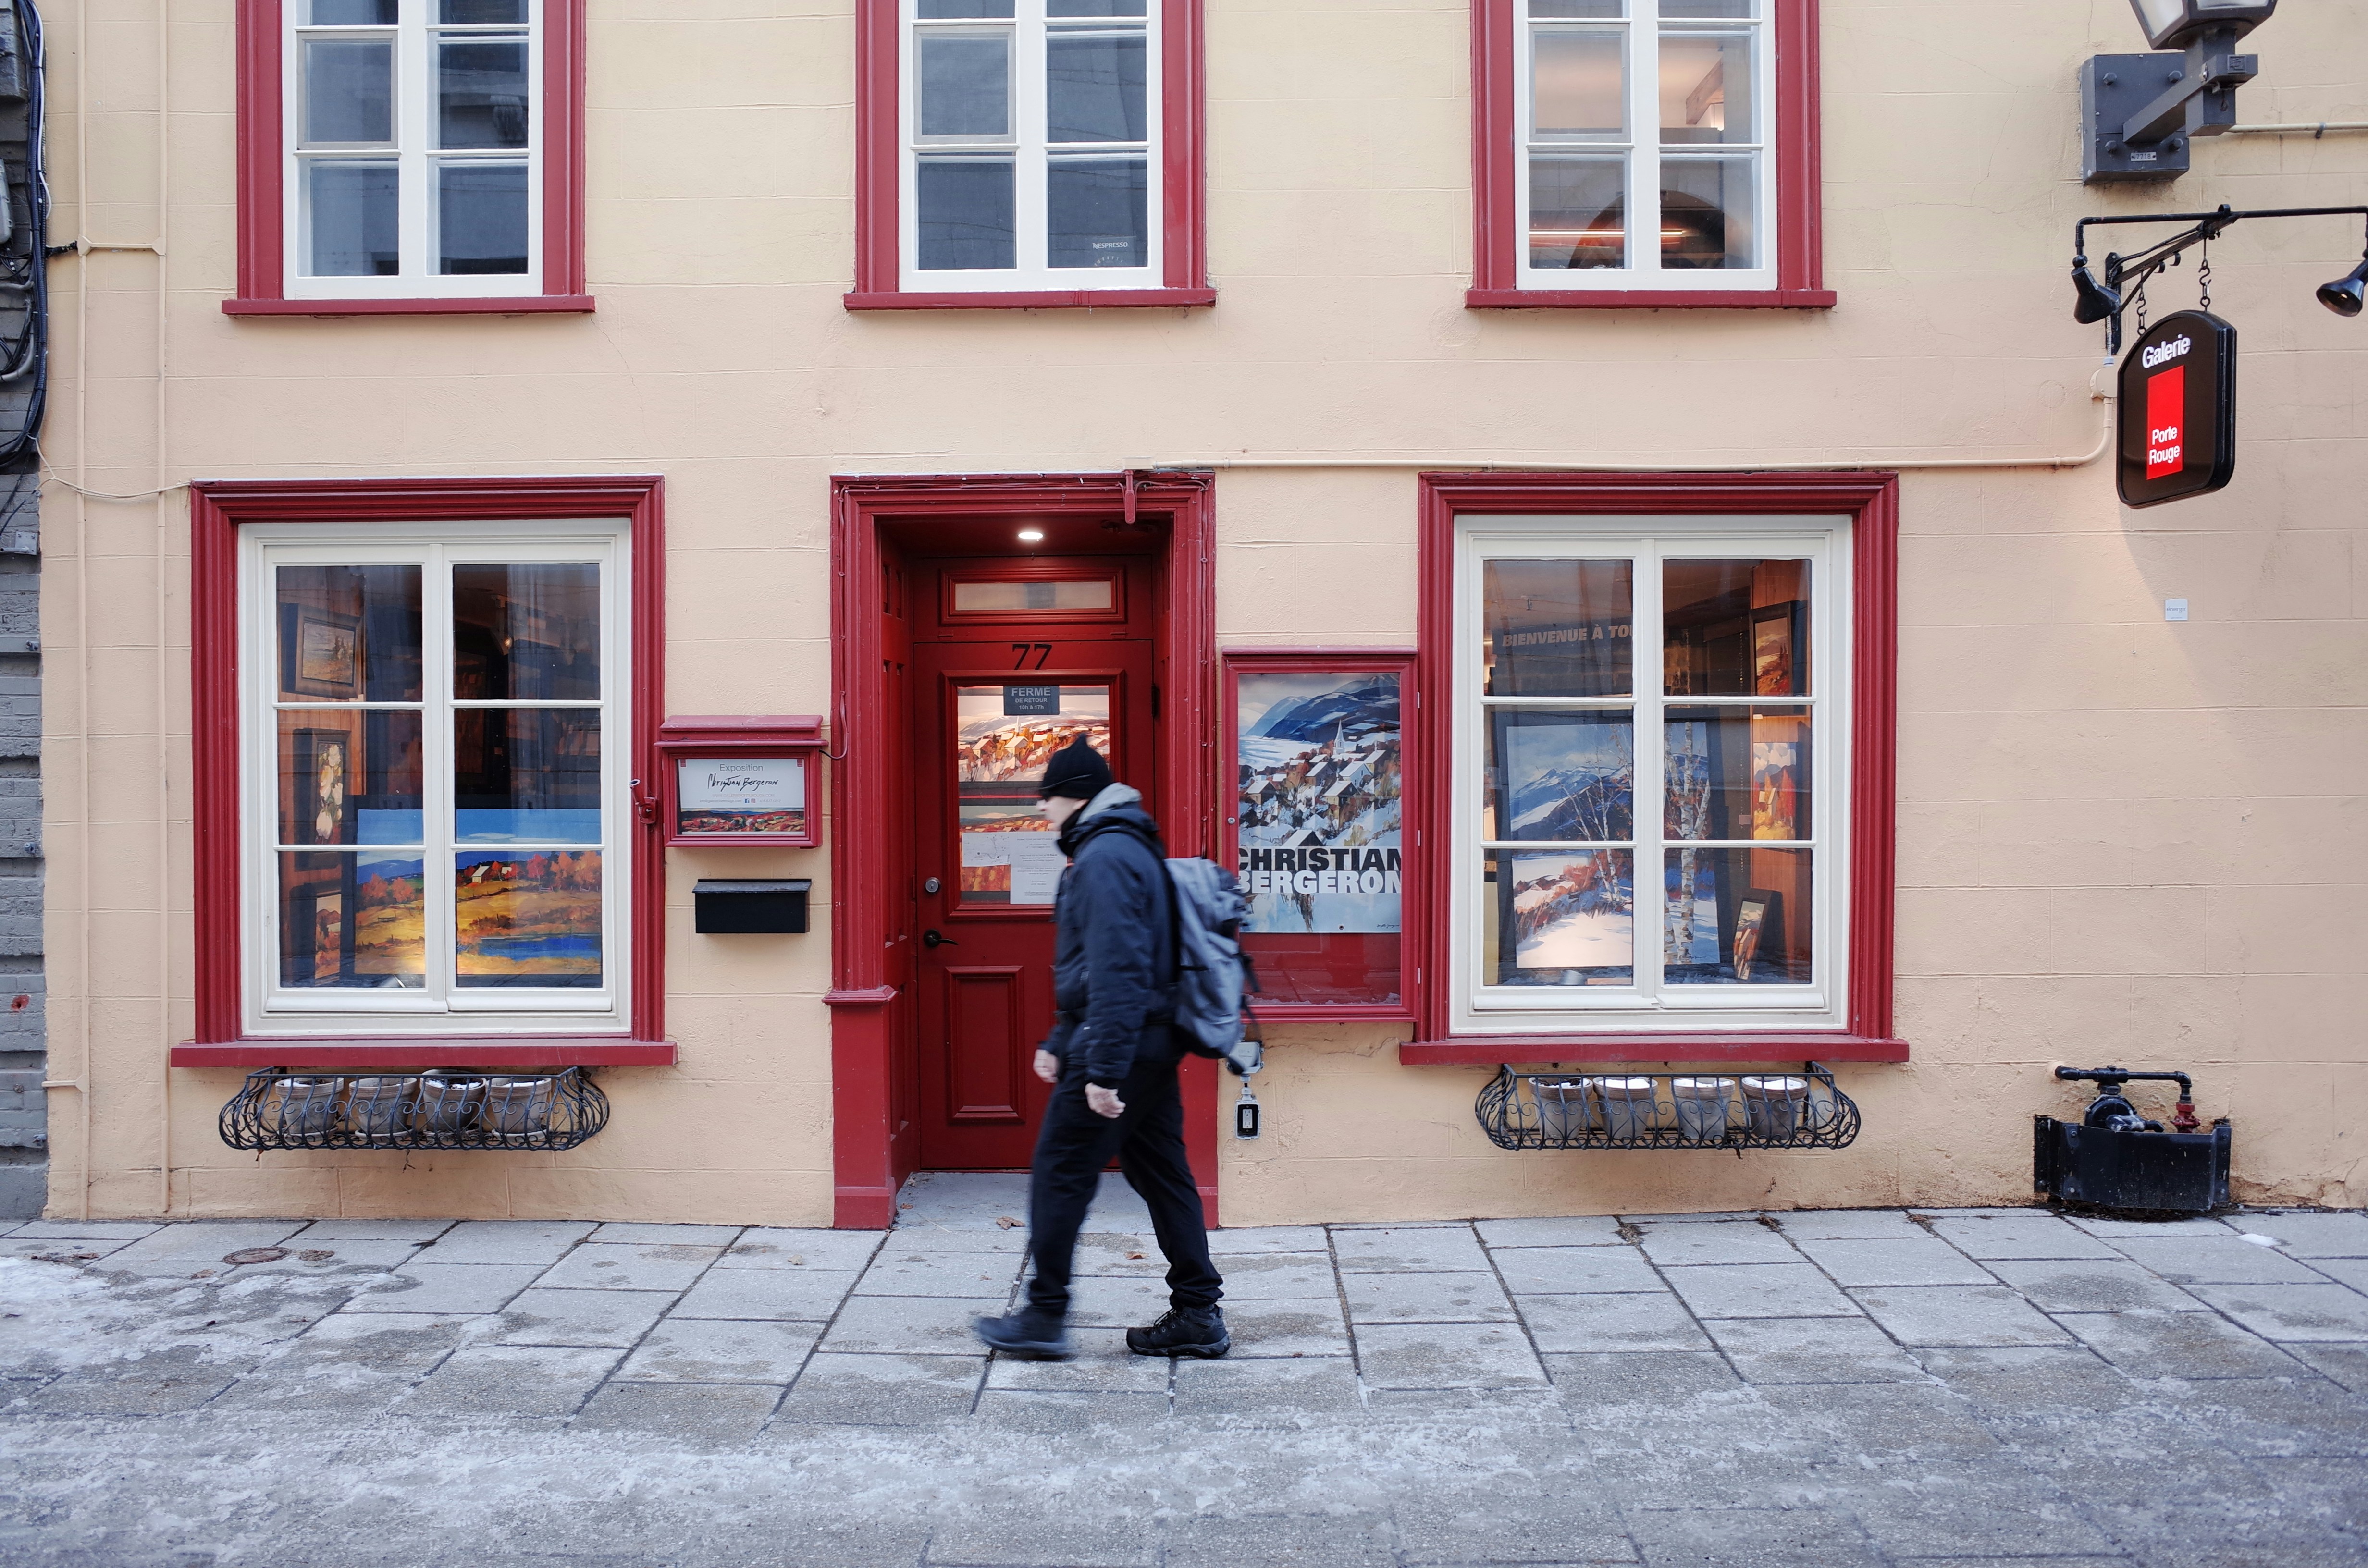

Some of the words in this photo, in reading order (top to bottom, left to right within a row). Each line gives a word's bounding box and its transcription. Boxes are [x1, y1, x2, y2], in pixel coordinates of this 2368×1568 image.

[1092, 242, 1128, 250] NESPRESSO
[2142, 334, 2191, 368] Galerie
[2152, 426, 2178, 445] Porte
[2149, 445, 2180, 465] Rouge
[1502, 627, 1587, 647] BIENVENUE
[1591, 624, 1603, 640] À
[1608, 625, 1632, 638] TO
[1012, 643, 1052, 670] 77
[1011, 686, 1051, 696] FERMÉ
[720, 764, 764, 772] Exposition
